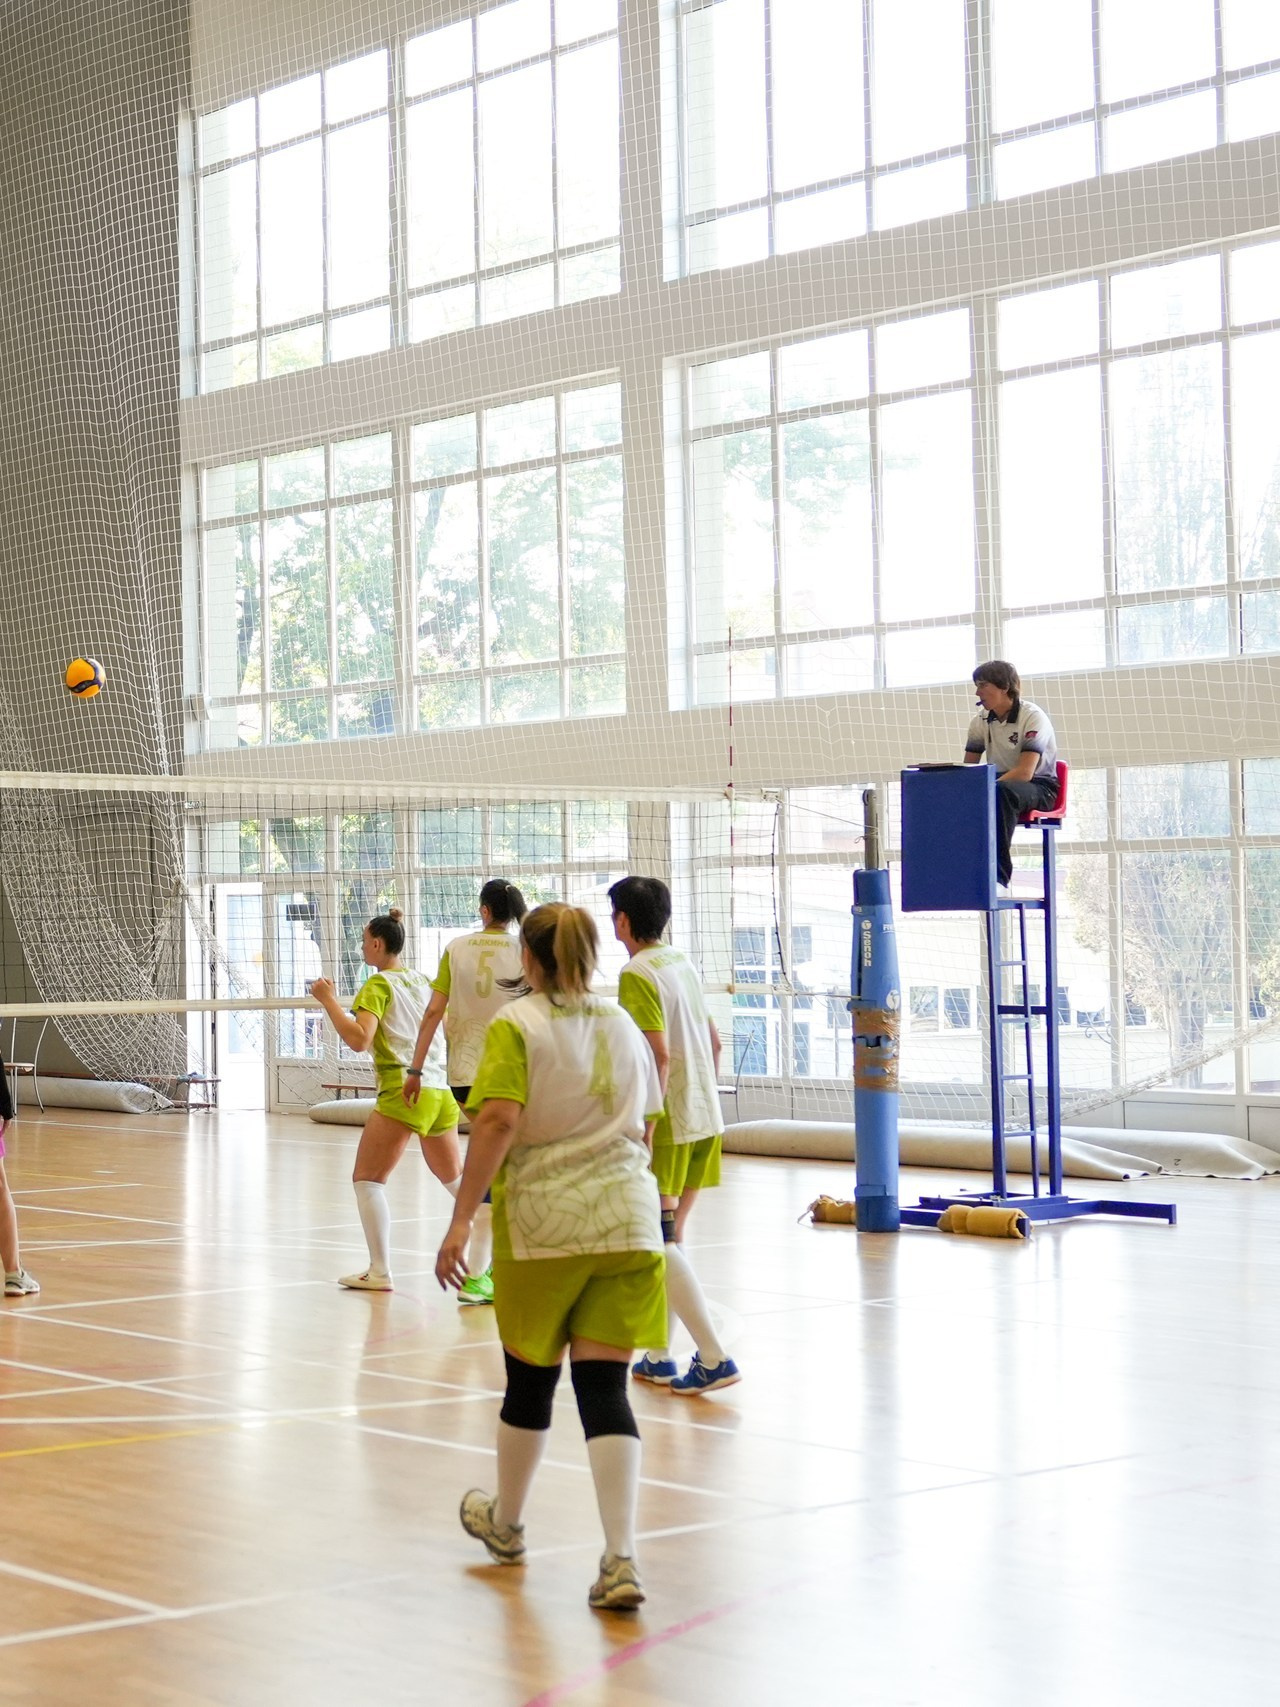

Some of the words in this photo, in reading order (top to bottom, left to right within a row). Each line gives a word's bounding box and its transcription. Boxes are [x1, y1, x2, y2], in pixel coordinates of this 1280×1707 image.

[863, 931, 872, 967] Senoh
[475, 950, 495, 998] 5
[587, 1030, 618, 1115] 4
